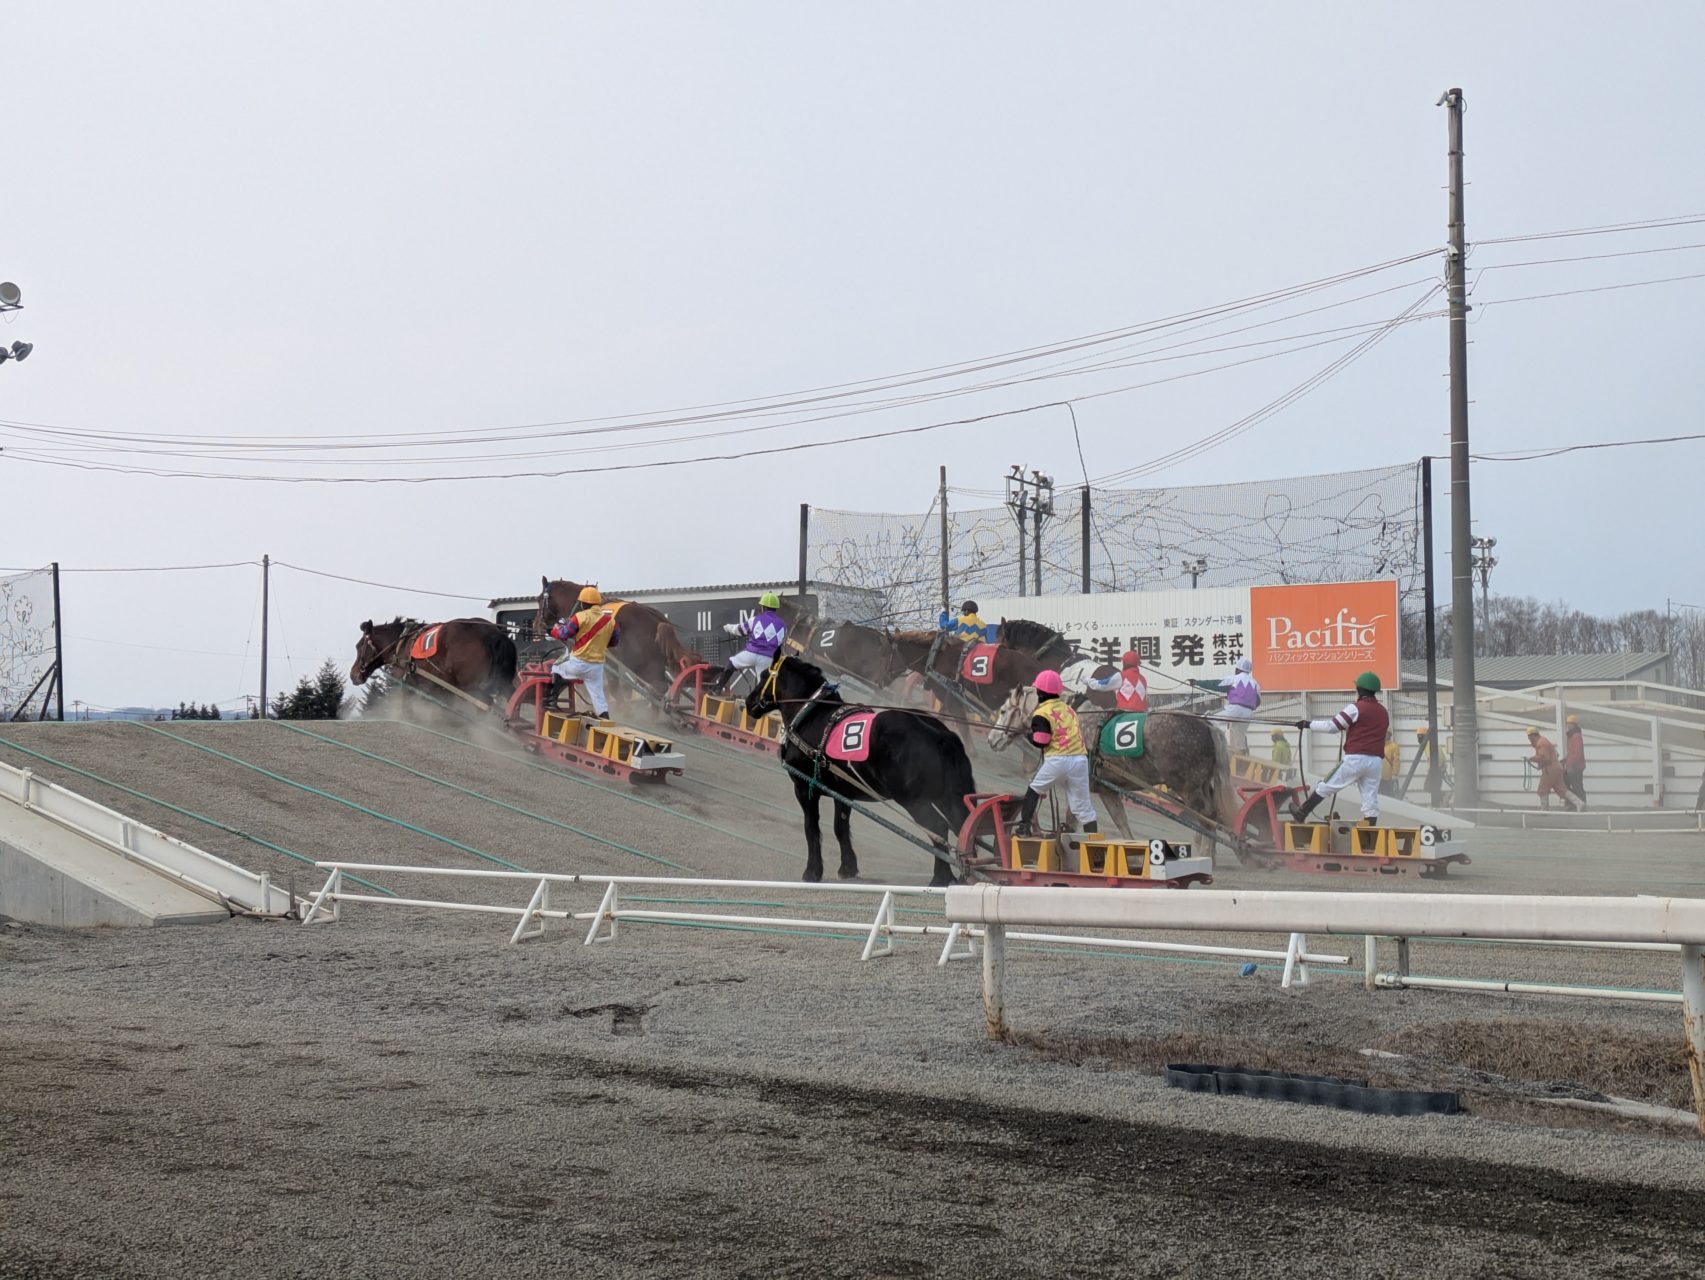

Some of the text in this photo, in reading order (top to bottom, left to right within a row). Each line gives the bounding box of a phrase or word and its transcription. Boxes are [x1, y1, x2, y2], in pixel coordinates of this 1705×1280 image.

[1044, 621, 1098, 632] らしをつくる
[1185, 615, 1242, 627] スタンダード市場
[1266, 607, 1388, 649] Pacific
[423, 631, 434, 650] 7
[820, 630, 834, 647] 2
[1269, 650, 1373, 662] パシフィックマンションシリーズ
[971, 656, 988, 676] 3
[844, 720, 865, 750] 8
[1116, 722, 1137, 748] 6
[634, 738, 644, 756] 7
[659, 743, 669, 753] 7
[1420, 825, 1436, 845] 6
[1442, 829, 1450, 842] 6
[1149, 839, 1165, 865] 8
[1178, 845, 1188, 857] 8
